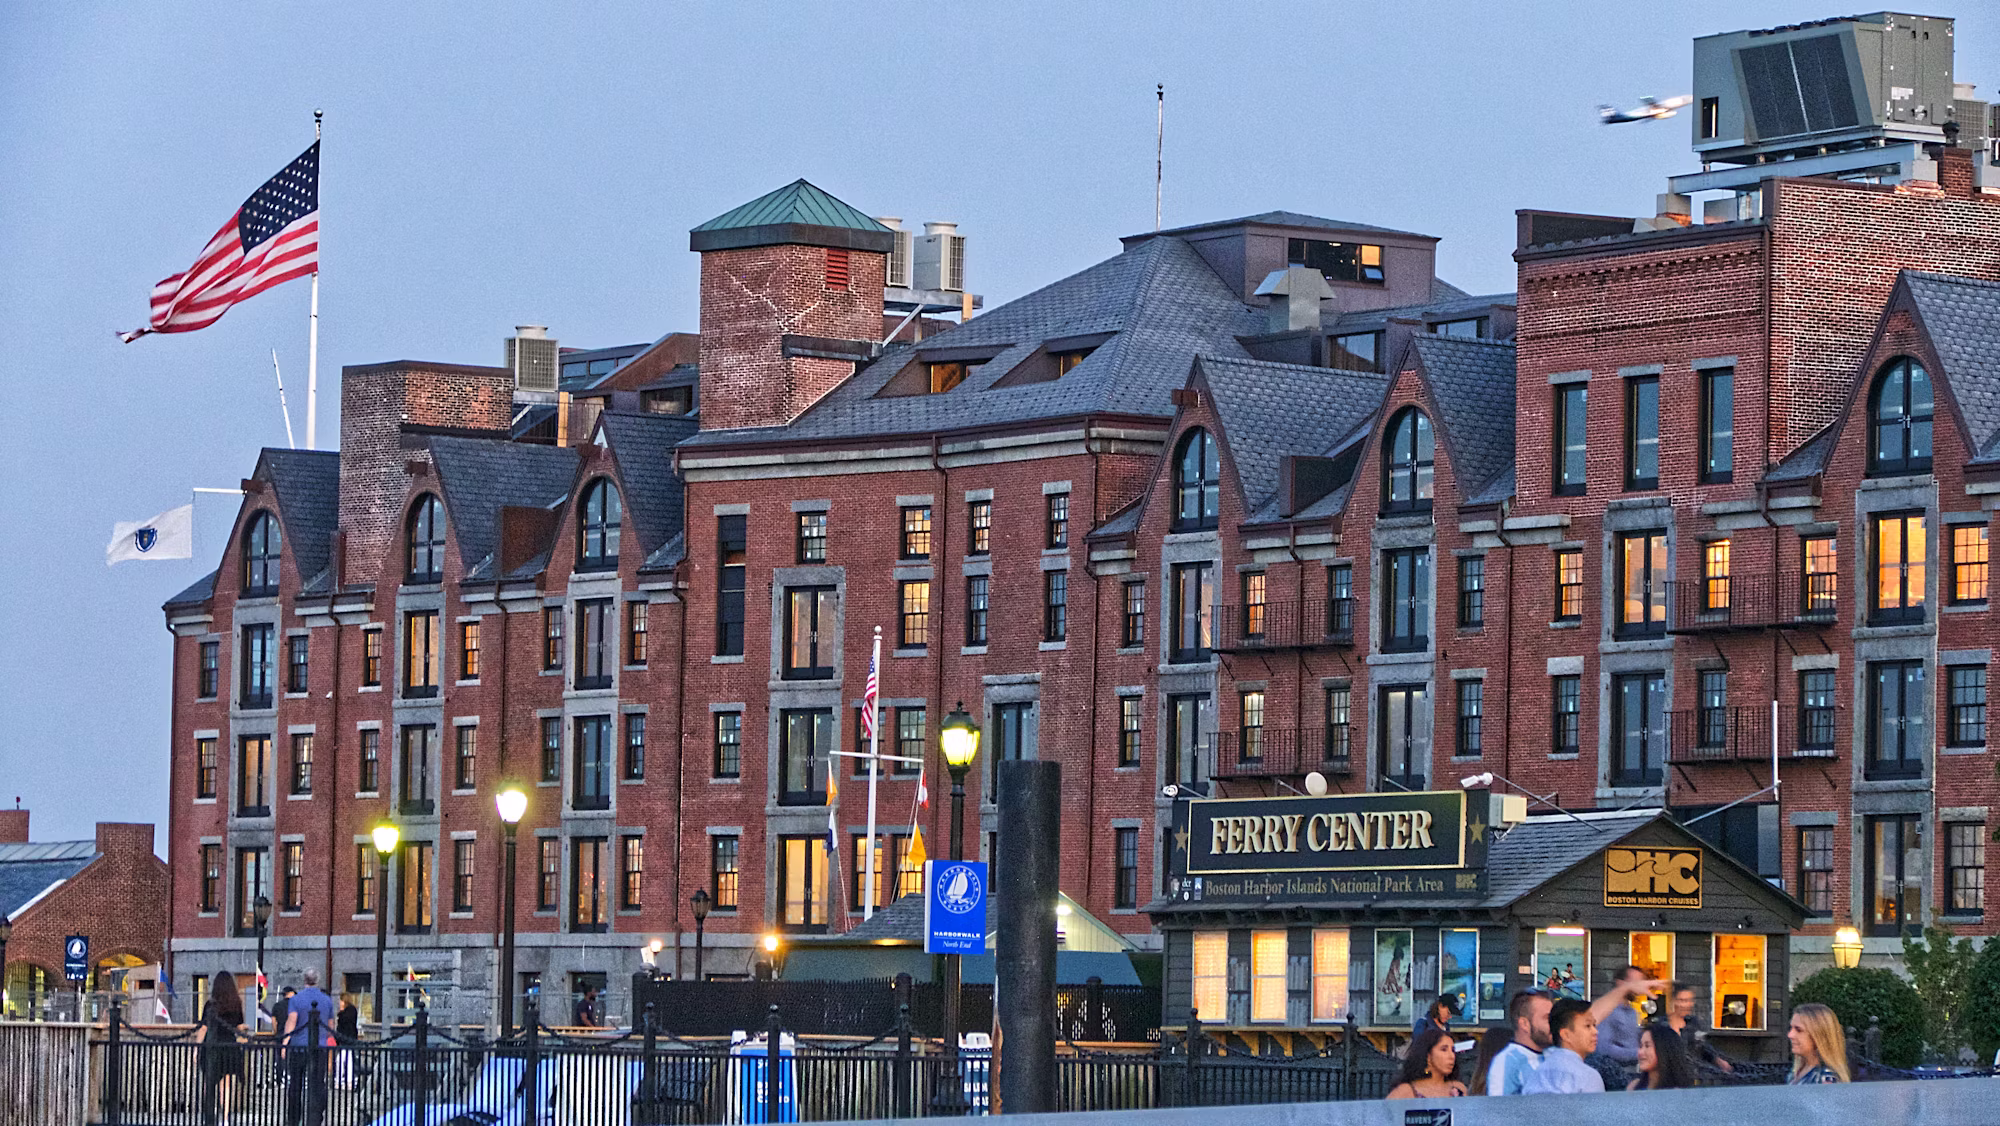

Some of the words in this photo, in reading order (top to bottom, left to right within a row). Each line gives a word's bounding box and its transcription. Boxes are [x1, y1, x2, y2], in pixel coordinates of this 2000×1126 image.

[1210, 815, 1304, 854] FERRY
[1307, 810, 1434, 852] CENTER
[1206, 881, 1240, 896] Boston
[1244, 879, 1284, 895] Harbor
[1286, 877, 1327, 894] Islands
[1331, 876, 1381, 893] National
[1385, 876, 1413, 893] Park
[1416, 877, 1444, 893] Area
[1637, 897, 1668, 905] HARBOR
